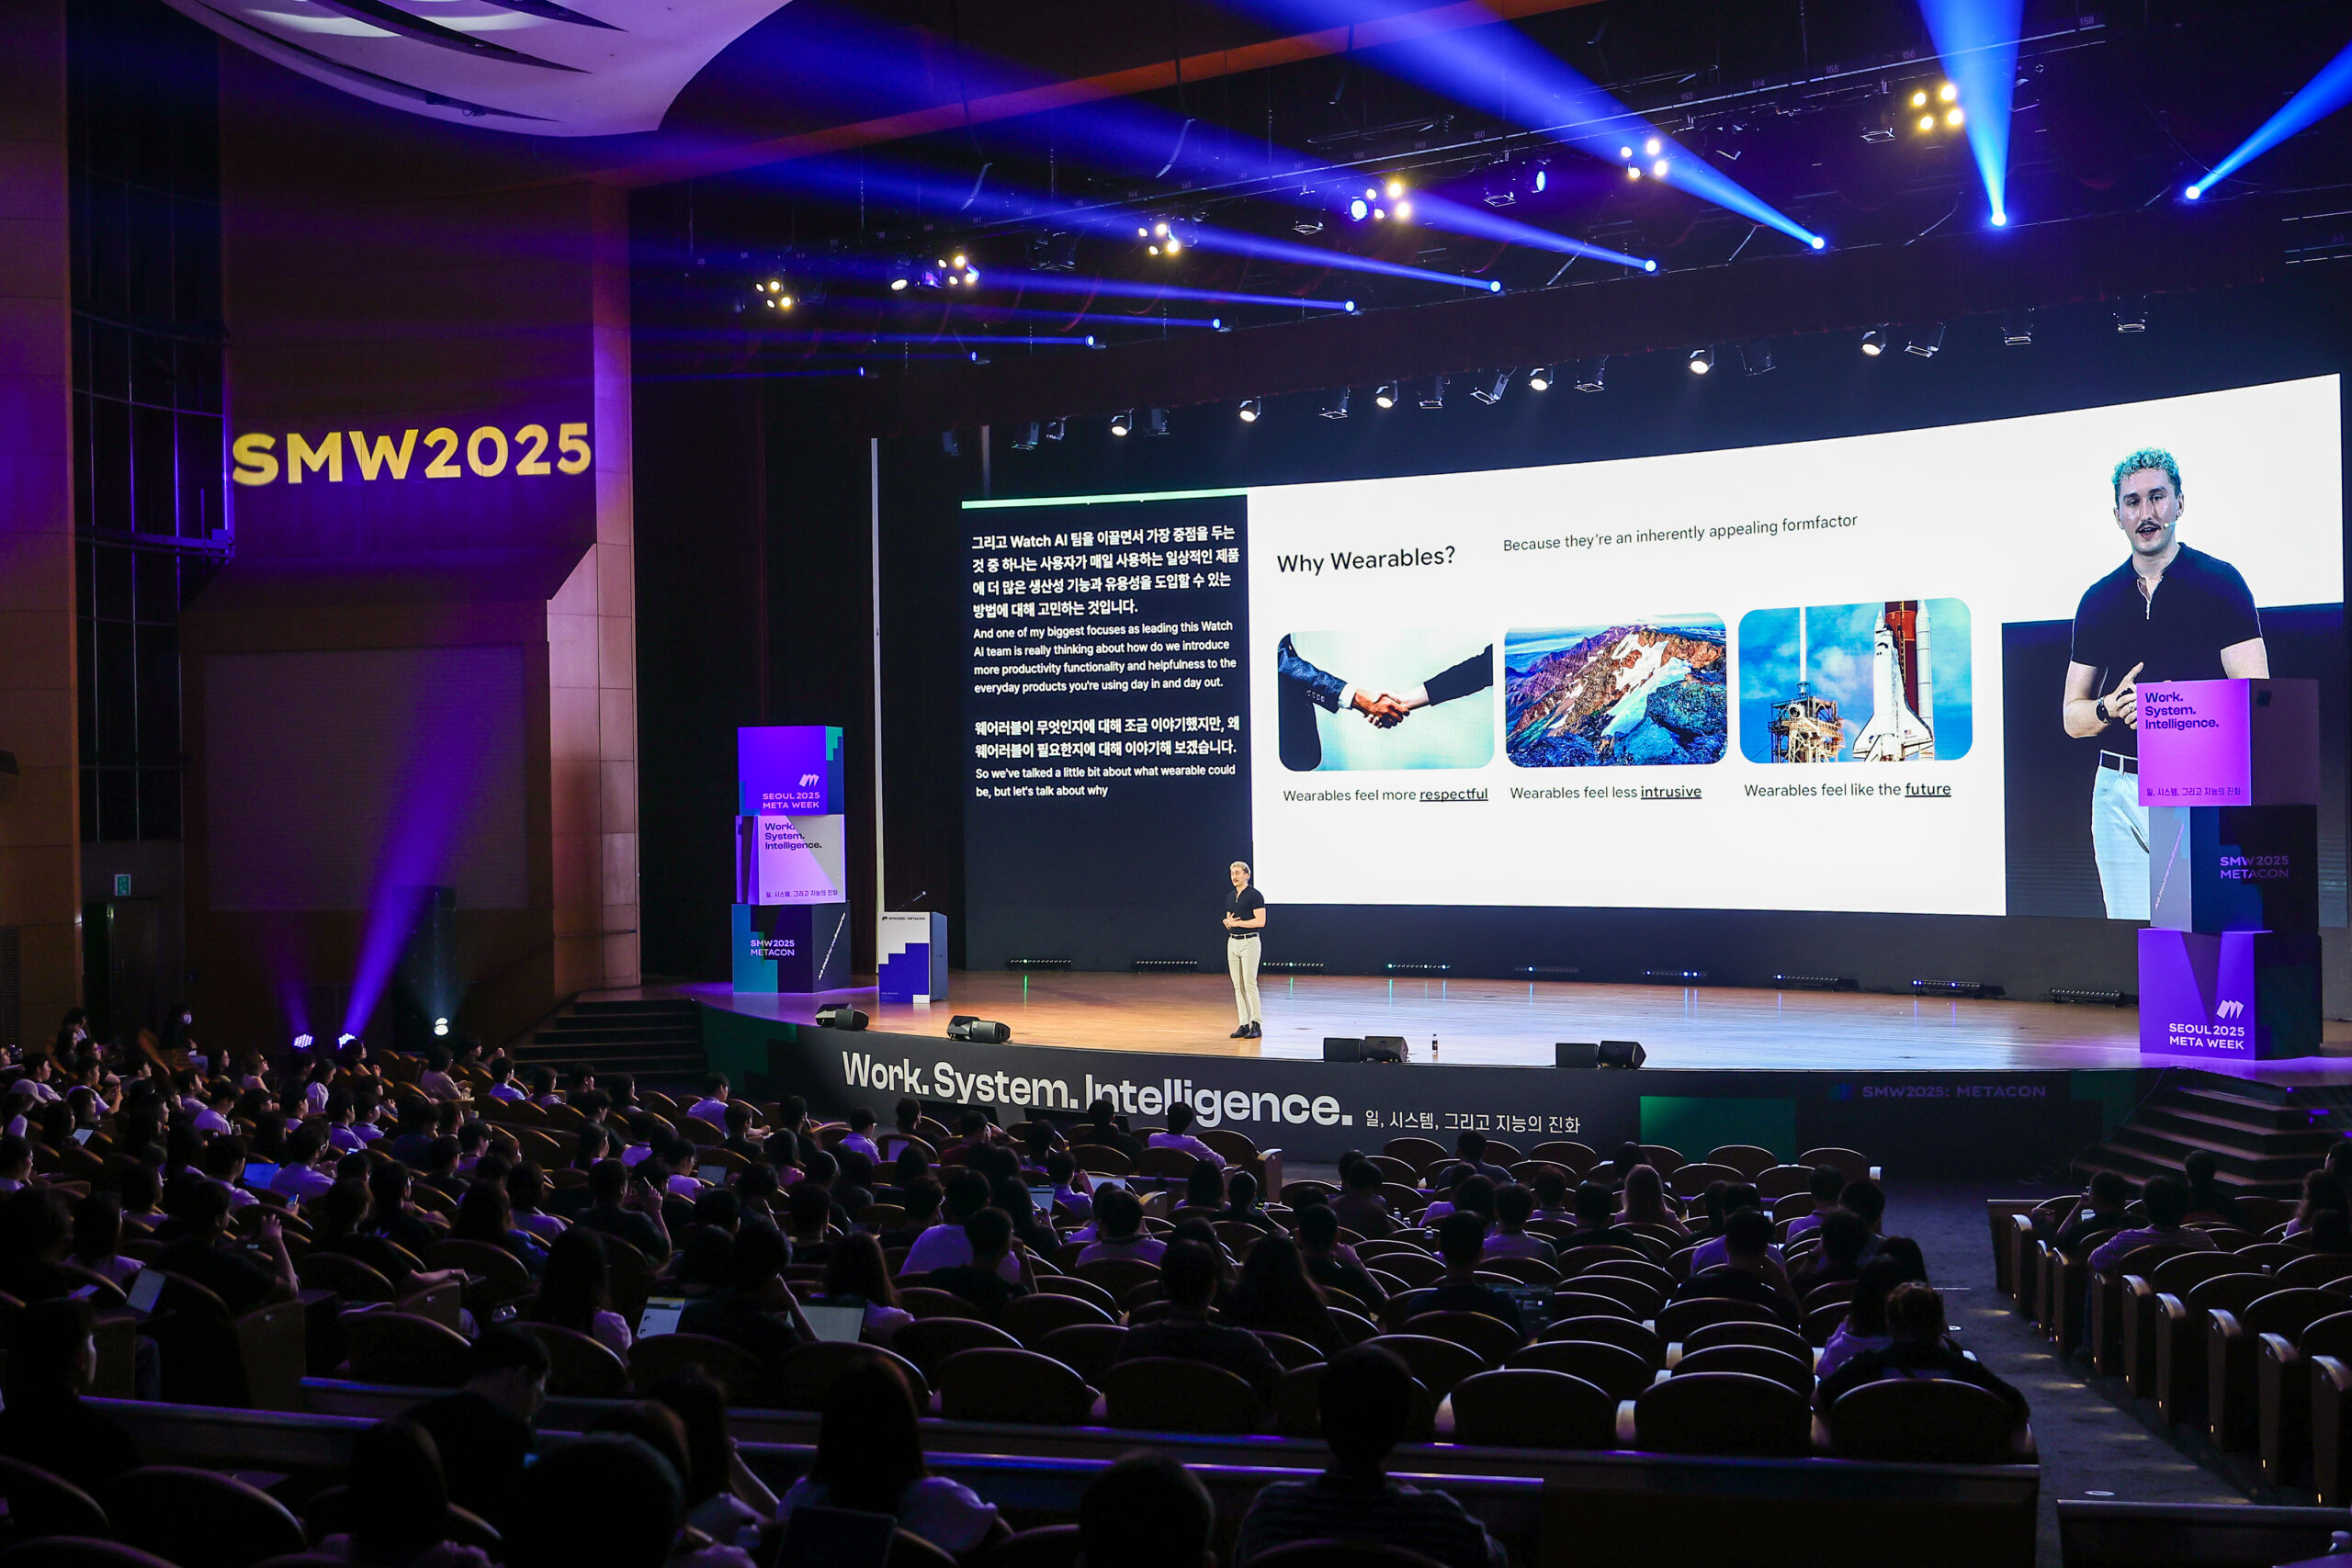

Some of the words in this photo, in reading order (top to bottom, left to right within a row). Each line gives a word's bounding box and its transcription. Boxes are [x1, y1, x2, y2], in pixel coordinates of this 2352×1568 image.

[232, 423, 591, 486] SMW2025
[971, 535, 1007, 549] 그리고
[1010, 535, 1051, 547] Watch
[1054, 534, 1068, 546] AI
[1070, 531, 1094, 547] 팀을
[1097, 528, 1143, 546] 이끌면서
[1147, 527, 1170, 543] 가장
[1172, 525, 1208, 542] 중점을
[1211, 525, 1235, 540] 두는
[1504, 538, 1560, 551] Because
[1616, 534, 1632, 544] an
[1636, 525, 1704, 542] inherently
[1709, 520, 1777, 539] appealing
[1782, 515, 1857, 531] formfactor
[972, 558, 984, 573] 것
[987, 558, 999, 572] 중
[1001, 557, 1037, 571] 하나는
[1040, 554, 1087, 570] 사용자가
[1090, 553, 1113, 569] 매일
[1115, 551, 1163, 568] 사용하는
[1166, 548, 1212, 566] 일상적인
[1216, 547, 1239, 563] 제품
[1277, 554, 1324, 576] Why
[1330, 546, 1454, 570] Wearables?
[972, 581, 984, 595] 에
[988, 580, 999, 595] 더
[1002, 580, 1026, 594] 많은
[1028, 578, 1063, 593] 생산성
[1067, 576, 1102, 592] 기능과
[1104, 575, 1152, 592] 유용성을
[1154, 573, 1190, 589] 도입할
[1193, 572, 1204, 588] 수
[1207, 571, 1231, 587] 있는
[973, 603, 1008, 618] 방법에
[1011, 602, 1035, 617] 대해
[1037, 601, 1084, 615] 고민하는
[1088, 598, 1137, 615] 것입니다.
[973, 627, 993, 638] And
[996, 629, 1014, 637] one
[1017, 626, 1027, 637] of
[1030, 628, 1045, 638] my
[1046, 626, 1084, 638] biggest
[1086, 625, 1125, 635] focuses
[1127, 626, 1139, 634] as
[1142, 622, 1178, 635] leading
[1180, 621, 1199, 632] this
[1201, 620, 1232, 631] Watch
[973, 647, 984, 657] AI
[986, 647, 1012, 656] team
[1013, 645, 1023, 656] is
[1024, 645, 1051, 657] really
[1053, 643, 1093, 656] thinking
[1095, 643, 1125, 653] about
[1126, 642, 1148, 652] how
[1150, 641, 1163, 651] do
[1165, 642, 1180, 651] we
[1182, 639, 1229, 650] introduce
[974, 666, 1000, 674] more
[1001, 662, 1061, 676] productivity
[1063, 660, 1125, 673] functionality
[1126, 660, 1146, 671] and
[1148, 659, 1204, 671] helpfulness
[1207, 659, 1217, 668] to
[1219, 657, 1236, 668] the
[974, 682, 1020, 694] everyday
[1022, 681, 1067, 694] products
[1102, 679, 1128, 692] using
[1130, 679, 1148, 691] day
[1151, 678, 1159, 688] in
[1162, 678, 1181, 688] and
[1183, 677, 1202, 690] day
[1204, 677, 1223, 687] out.
[2145, 692, 2183, 702] Work.
[2145, 705, 2196, 718] System.
[975, 720, 1033, 736] 웨어러블이
[1036, 718, 1094, 735] 무엇인지에
[1098, 718, 1121, 733] 대해
[1124, 717, 1148, 732] 조금
[1150, 716, 1224, 732] 이야기했지만,
[1227, 715, 1239, 730] 왜
[2145, 718, 2219, 730] Intelligence.
[975, 742, 1034, 758] 웨어러블이
[1036, 741, 1095, 757] 필요한지에
[1098, 741, 1122, 756] 대해
[1125, 739, 1171, 756] 이야기해
[1174, 739, 1236, 754] 보겠습니다.
[976, 768, 989, 778] So
[1022, 767, 1053, 778] talked
[1055, 769, 1061, 777] a
[1063, 767, 1085, 777] little
[1087, 766, 1101, 776] bit
[1102, 766, 1132, 776] about
[1133, 765, 1159, 776] what
[1160, 764, 1205, 775] wearable
[1207, 764, 1235, 774] could
[976, 786, 991, 798] be,
[994, 786, 1011, 796] but
[1035, 785, 1054, 795] talk
[1056, 785, 1085, 795] about
[1087, 784, 1108, 797] why
[1283, 790, 1351, 801] Wearables
[1355, 789, 1378, 800] feel
[1383, 791, 1416, 800] more
[1419, 787, 1488, 802] respectful
[1510, 787, 1579, 798] Wearables
[1584, 786, 1608, 797] feel
[1612, 786, 1637, 797] less
[1640, 785, 1702, 800] intrusive
[1744, 784, 1816, 796] Wearables
[1821, 783, 1846, 795] feel
[1850, 783, 1873, 795] like
[1878, 783, 1901, 795] the
[1905, 783, 1951, 797] future
[2147, 787, 2155, 796] 일,
[2157, 787, 2179, 795] 시스템,
[2182, 787, 2201, 795] 그리고
[2204, 787, 2224, 795] 지능의
[2227, 787, 2242, 795] 진화
[765, 832, 805, 841] System.
[765, 841, 821, 851] Intelligence.
[2220, 856, 2290, 866] SMW2025
[2221, 869, 2289, 879] METACON
[2169, 1036, 2203, 1047] META
[2207, 1038, 2245, 1050] WEEK
[842, 1051, 929, 1095] Work.
[933, 1061, 1079, 1104] System.
[1086, 1073, 1353, 1127] Intelligence.
[1862, 1086, 1949, 1098] SMW2025:
[1956, 1085, 2045, 1097] METACON
[1365, 1110, 1384, 1127] 일,
[1389, 1111, 1438, 1130] 시스템,
[1444, 1113, 1489, 1130] 그리고
[1496, 1115, 1541, 1132] 지능의
[1548, 1116, 1580, 1134] 진화
